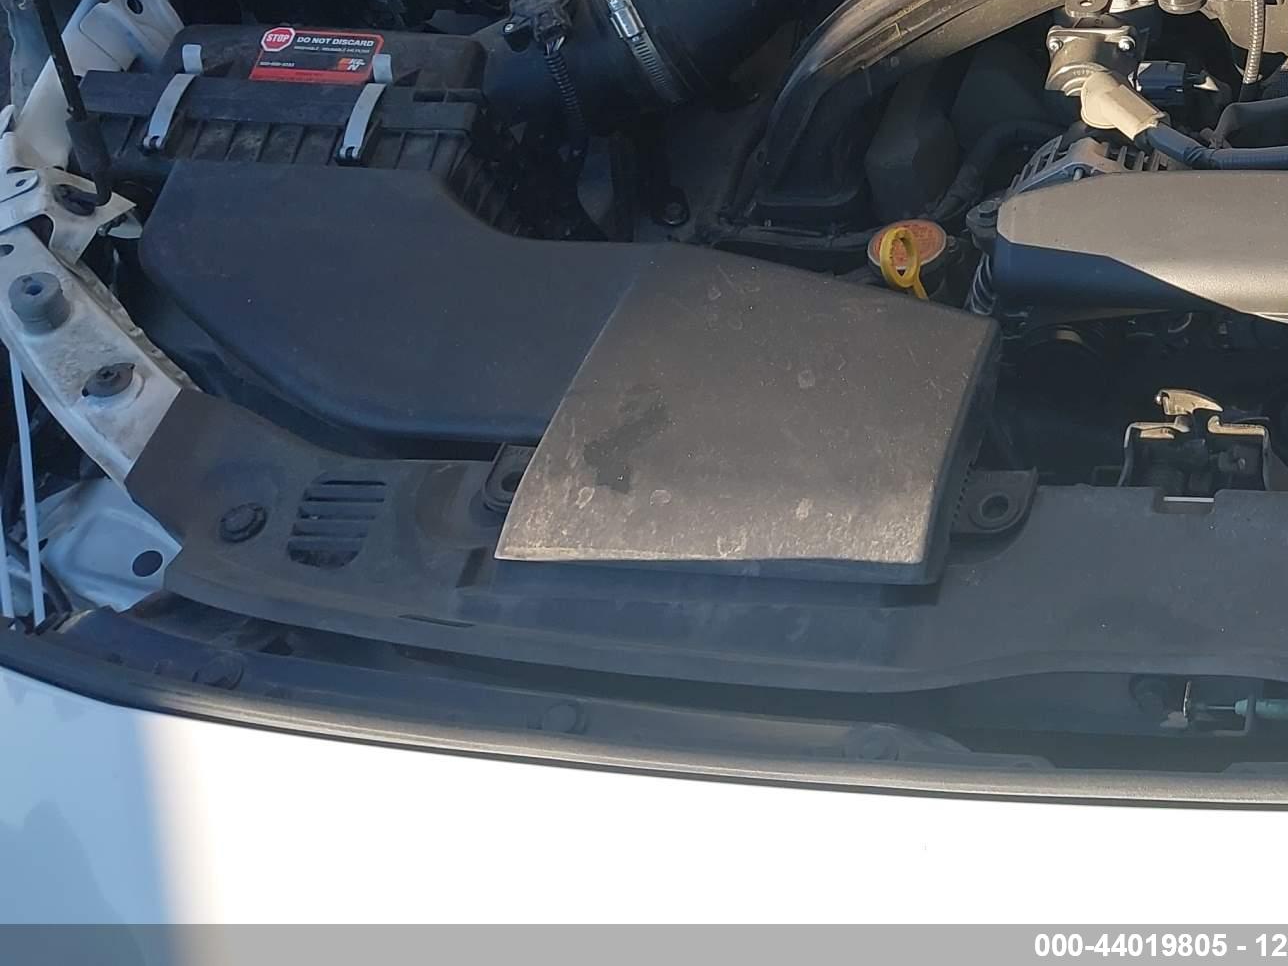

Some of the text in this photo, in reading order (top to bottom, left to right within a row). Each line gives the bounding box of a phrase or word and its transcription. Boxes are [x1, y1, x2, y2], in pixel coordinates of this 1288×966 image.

[266, 33, 290, 43] STOP
[296, 36, 374, 47] DO NOT DISCARD
